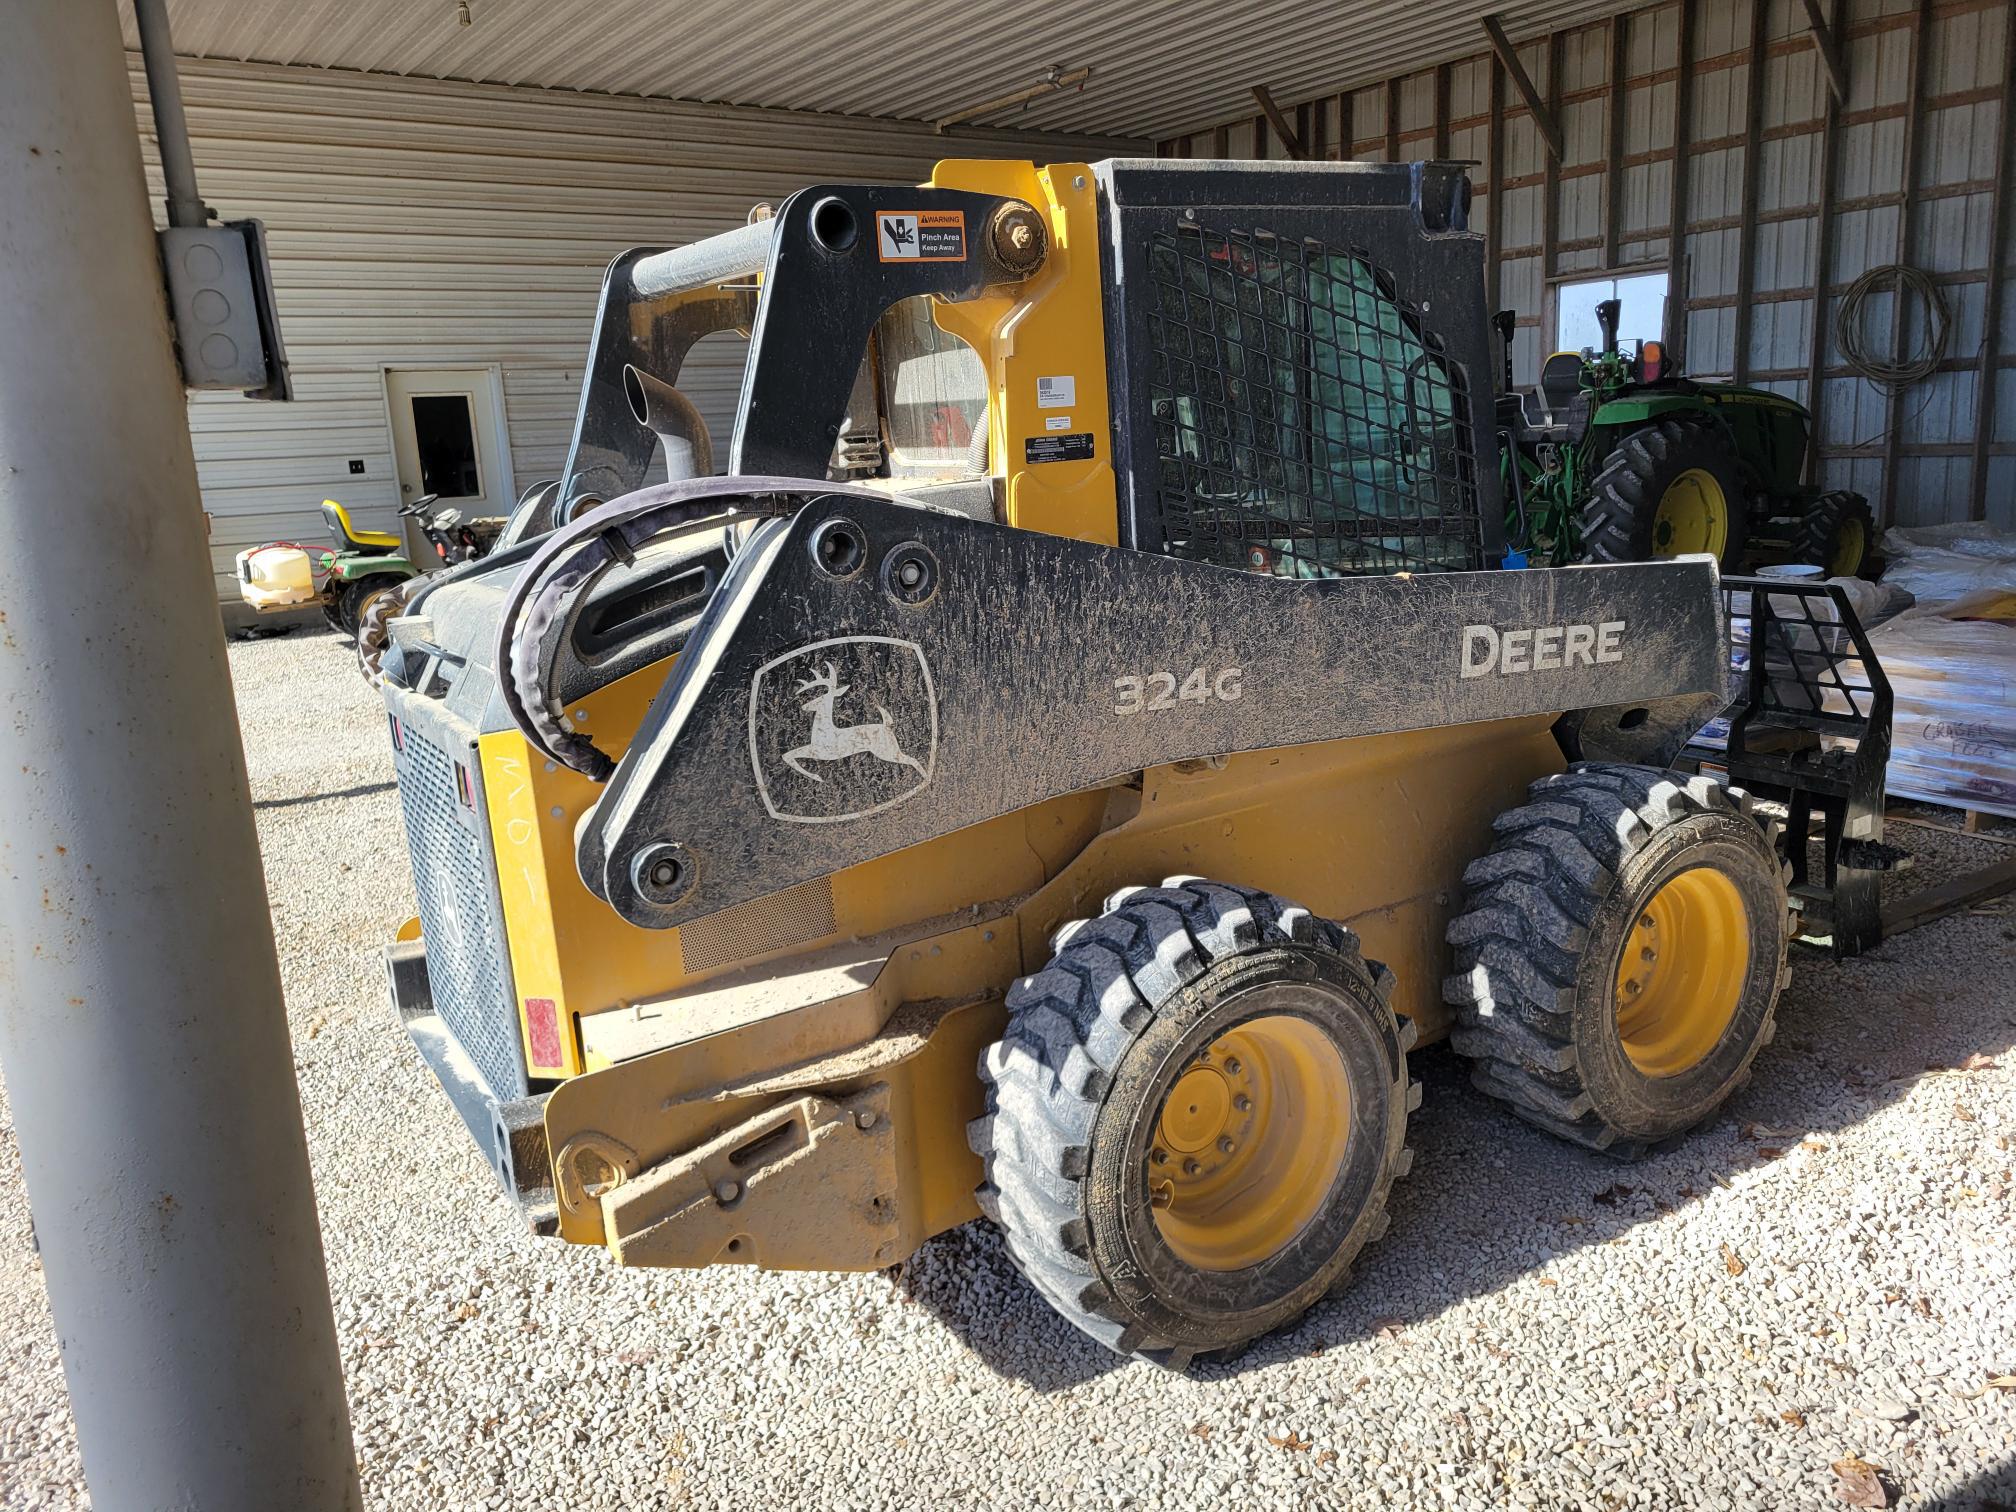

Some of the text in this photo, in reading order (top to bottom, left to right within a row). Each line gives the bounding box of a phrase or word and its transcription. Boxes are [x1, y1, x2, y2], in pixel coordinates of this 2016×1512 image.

[921, 233, 960, 241] Pinch Area
[922, 244, 956, 253] Keep Away
[1461, 620, 1626, 679] DEERE
[1114, 666, 1242, 716] 324G
